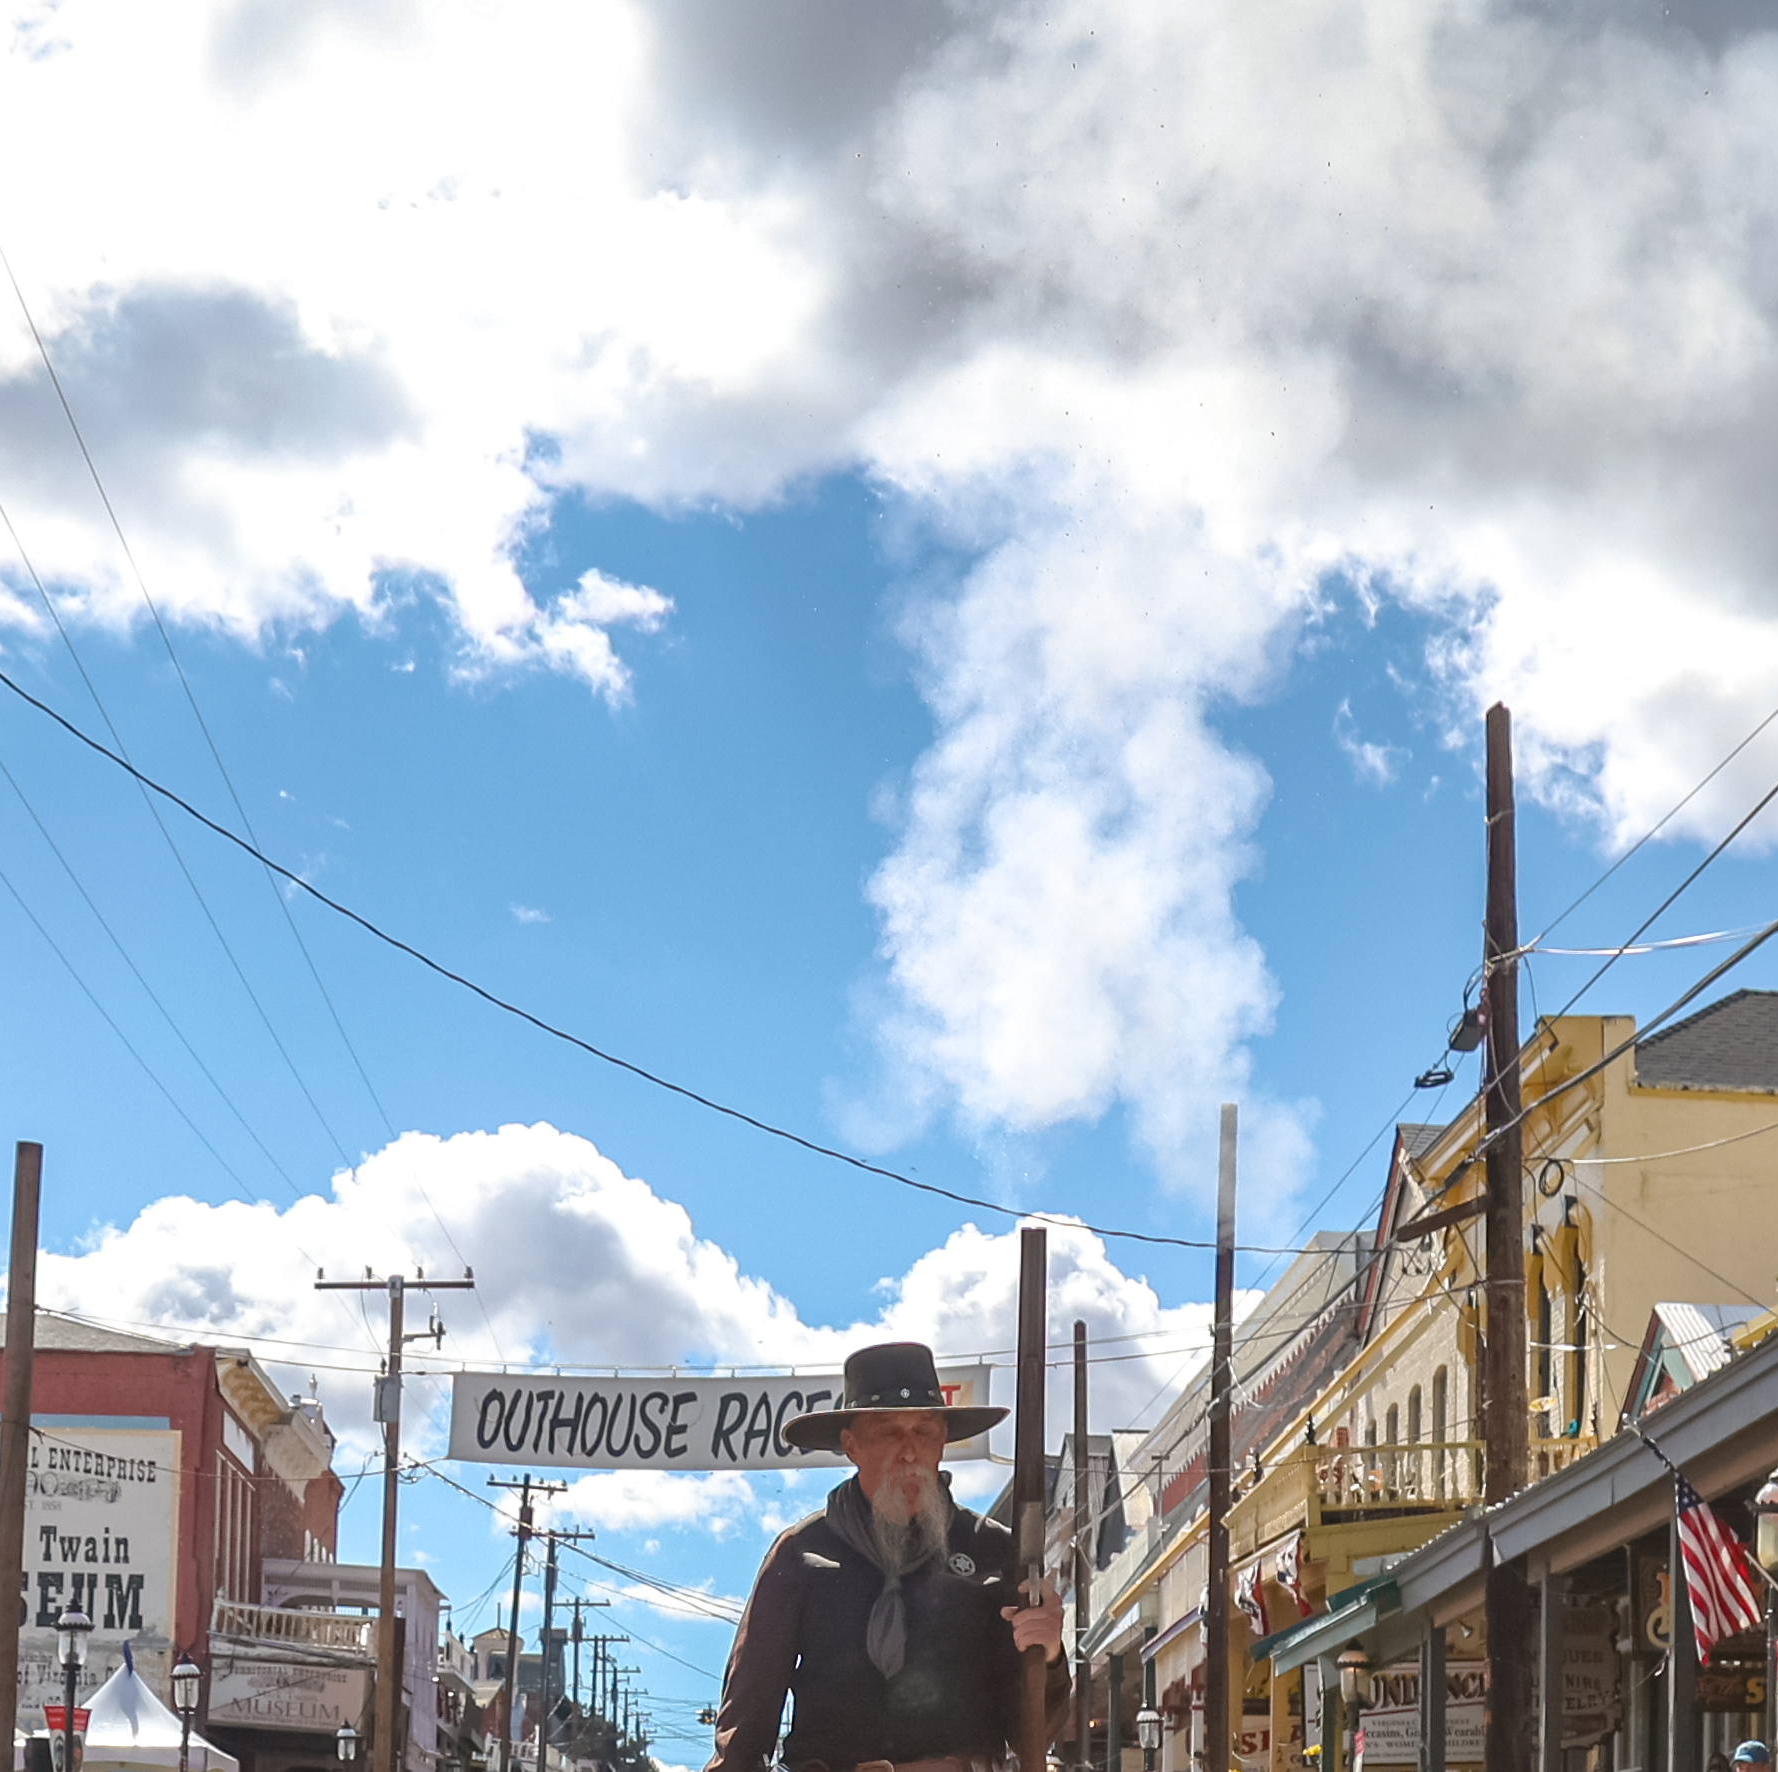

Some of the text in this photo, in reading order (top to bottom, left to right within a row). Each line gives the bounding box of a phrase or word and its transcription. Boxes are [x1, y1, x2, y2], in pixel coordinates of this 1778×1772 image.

[476, 1386, 697, 1459] OUTHOUSE
[49, 1447, 156, 1483] ENTERPRISE
[39, 1526, 129, 1563] Twain
[232, 1697, 340, 1722] MUSEUM
